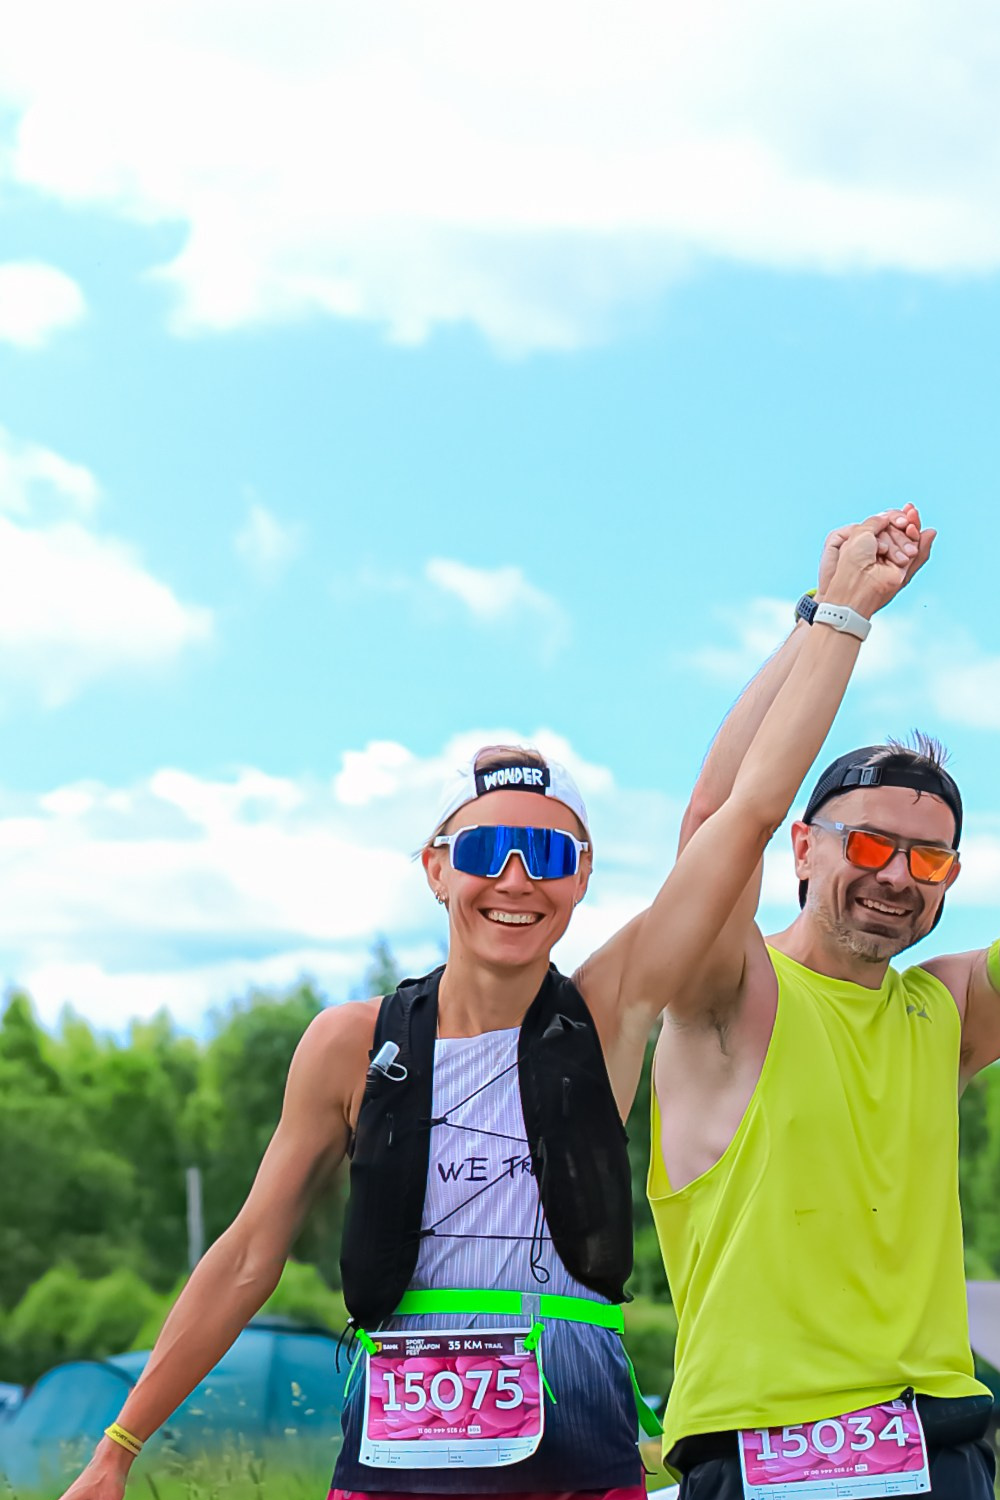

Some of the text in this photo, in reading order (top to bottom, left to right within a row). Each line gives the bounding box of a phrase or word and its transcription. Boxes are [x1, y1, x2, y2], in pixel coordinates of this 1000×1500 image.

[484, 767, 544, 790] WONDER
[438, 1155, 535, 1182] WE TR
[448, 1341, 460, 1349] 35
[464, 1340, 482, 1349] KM
[382, 1369, 524, 1412] 15075
[753, 1416, 909, 1461] 15034
